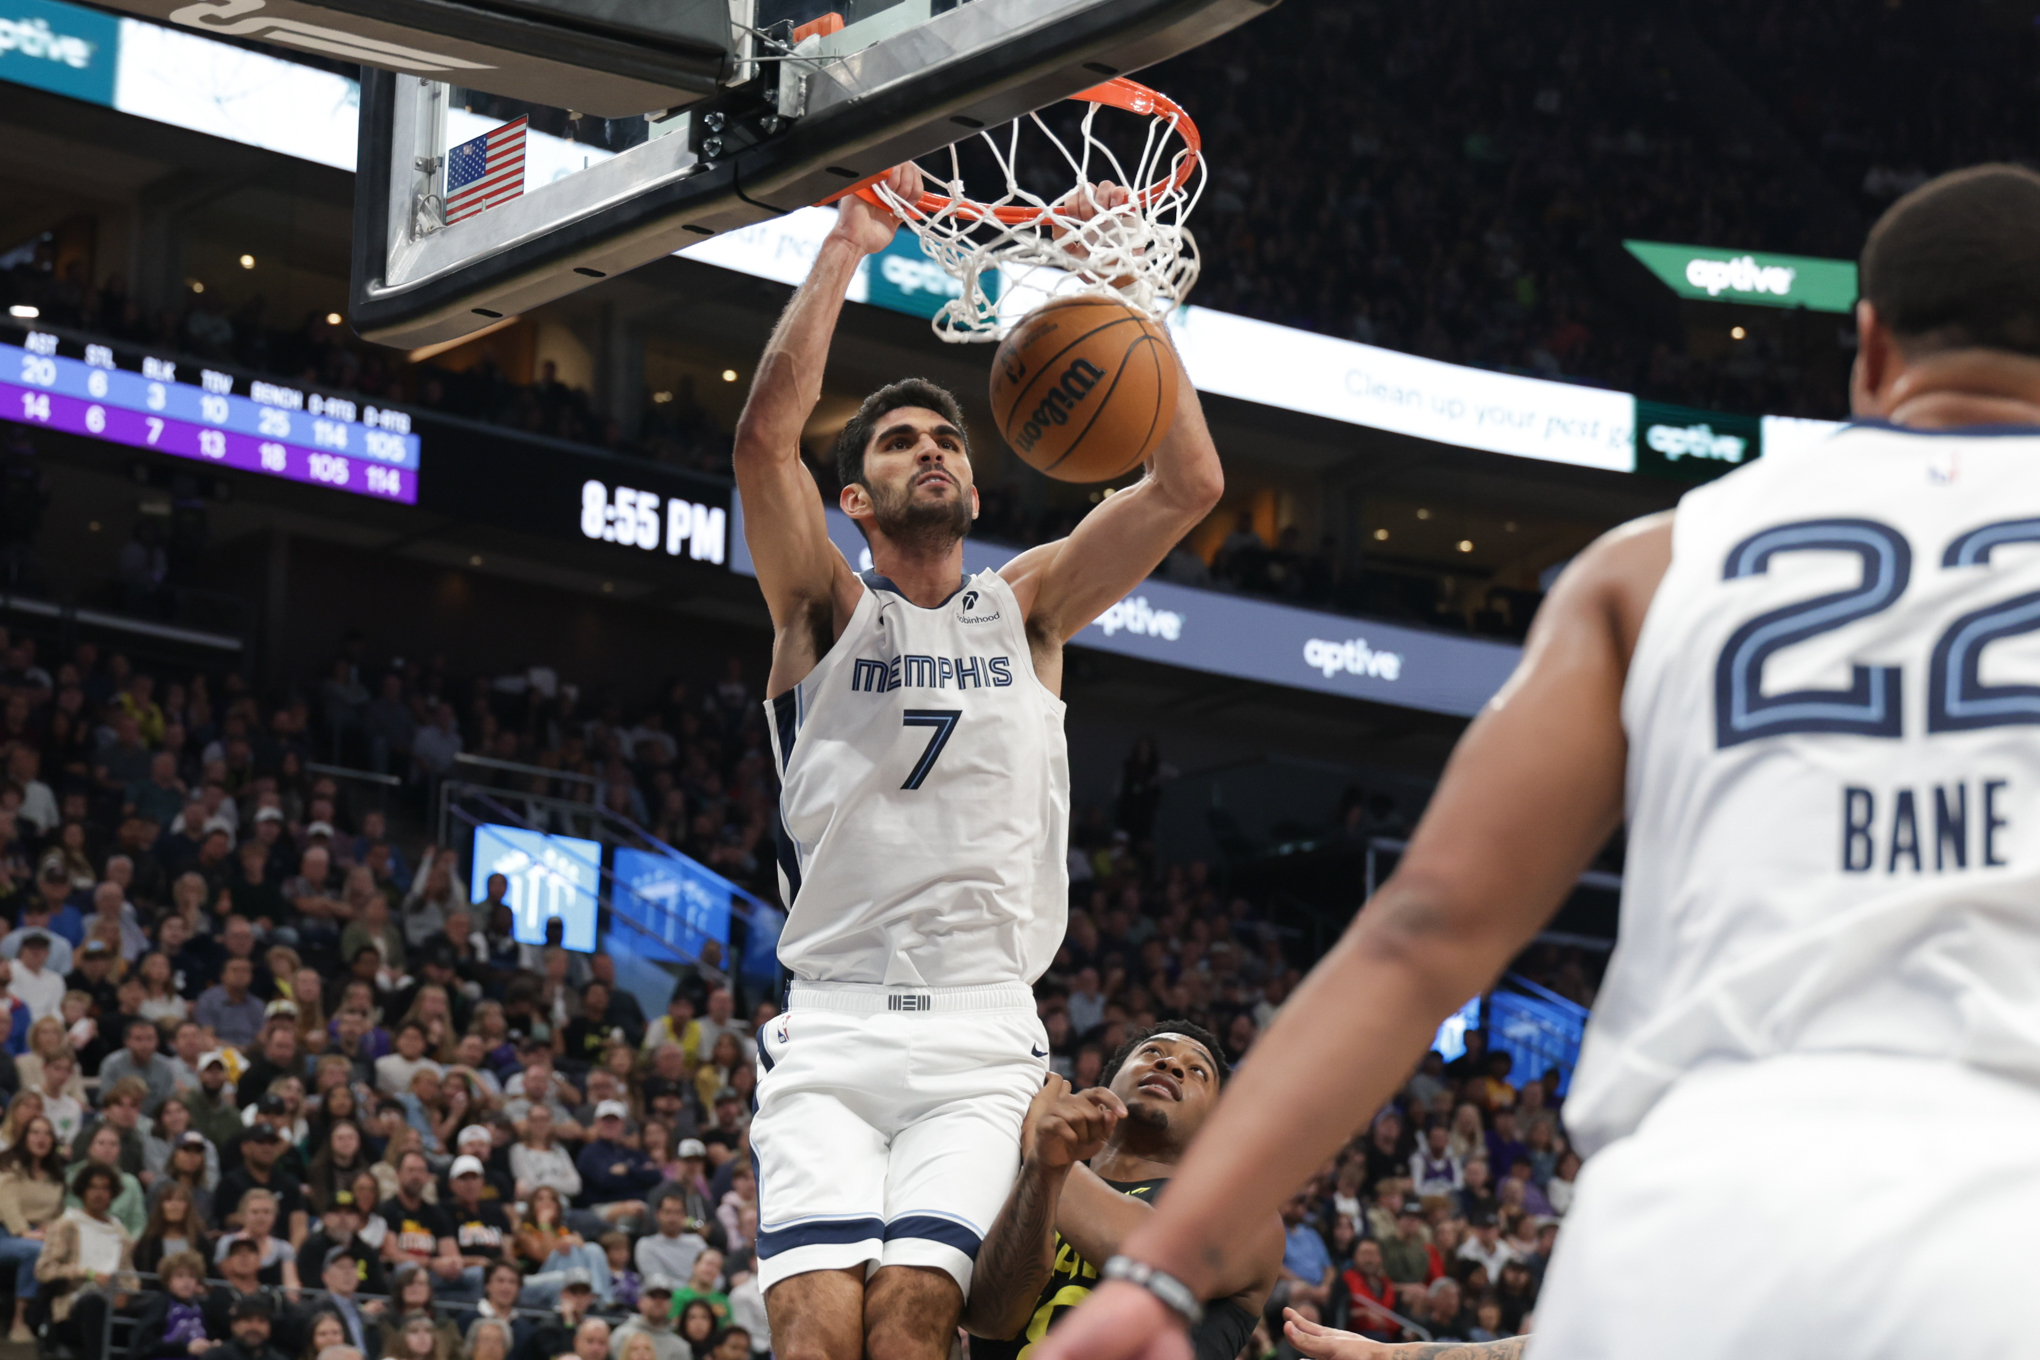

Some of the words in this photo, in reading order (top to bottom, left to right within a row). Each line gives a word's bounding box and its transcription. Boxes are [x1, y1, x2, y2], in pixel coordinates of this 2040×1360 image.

[1686, 255, 1791, 296] aptive
[24, 331, 59, 356] AST
[85, 343, 117, 370] STL
[142, 356, 176, 383] BLK
[21, 355, 57, 386] 20
[88, 369, 108, 398] 6
[147, 382, 166, 411] 3
[199, 395, 229, 424] 10
[258, 407, 290, 438] 25
[313, 419, 348, 449] 114
[365, 431, 406, 462] 105
[1015, 357, 1107, 453] Wilson
[1344, 367, 1423, 408] Clean
[1430, 395, 1466, 421] up
[1474, 402, 1537, 429] your
[21, 392, 51, 422] 14
[85, 405, 106, 433] 6
[145, 417, 164, 445] 7
[198, 429, 226, 459] 13
[308, 452, 349, 485] 105
[365, 465, 400, 496] 114
[1646, 422, 1744, 463] aptive
[581, 479, 660, 550] 8:55
[666, 497, 726, 565] PM
[852, 654, 1013, 693] MEMPHIS
[1303, 637, 1401, 681] aptive
[1715, 517, 2040, 750] 22
[900, 709, 962, 790] 7
[1843, 779, 2009, 874] BANE
